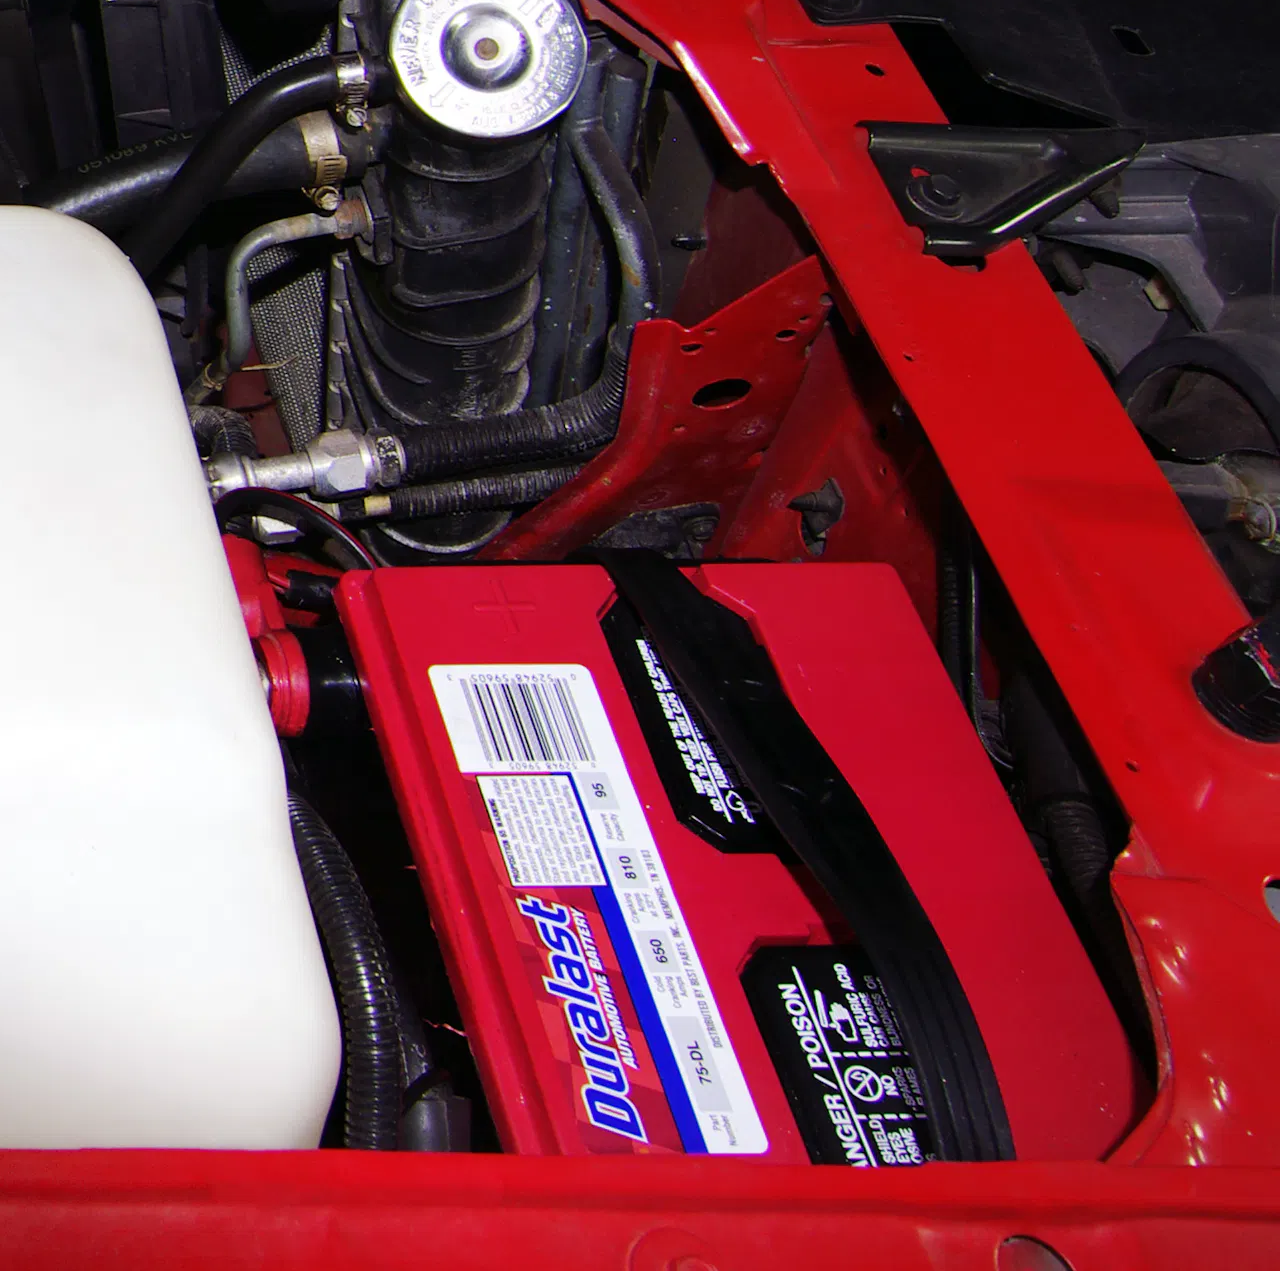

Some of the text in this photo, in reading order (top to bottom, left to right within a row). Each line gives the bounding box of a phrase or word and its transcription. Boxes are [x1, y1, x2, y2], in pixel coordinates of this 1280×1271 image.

[399, 19, 426, 85] NEVER
[635, 639, 658, 677] CHILDREN
[470, 673, 510, 683] 59605
[514, 672, 553, 682] 52948
[650, 679, 664, 690] OF
[656, 692, 674, 719] REACH
[666, 692, 683, 713] CAPS
[668, 721, 681, 737] THE
[675, 715, 692, 737] VENT
[674, 739, 688, 751] OF
[684, 738, 701, 759] KEEP
[508, 762, 541, 771] 59605
[544, 761, 578, 770] 52948
[681, 752, 696, 770] OUT
[689, 772, 704, 793] KEEP
[709, 762, 729, 787] FLUSH
[592, 782, 606, 797] 95
[701, 779, 716, 796] NOT
[709, 798, 722, 811] DO
[598, 813, 614, 839] Reserve
[609, 812, 626, 841] Capacity
[501, 839, 521, 882] PROPOSITION
[618, 855, 636, 879] 810
[649, 872, 660, 882] TN
[623, 892, 641, 923] Cranking
[633, 892, 646, 912] Amps
[649, 938, 667, 963] 650
[572, 907, 635, 1068] AUTOMOTIVE BATTERY
[653, 975, 665, 992] Cold
[674, 975, 688, 997] Amps
[686, 968, 698, 985] BEST
[863, 975, 877, 989] OR
[664, 975, 682, 1008] Cranking
[692, 988, 704, 998] BY
[831, 963, 878, 1047] SULFURIC ACID
[513, 894, 648, 1141] Duralast
[697, 1000, 722, 1047] DISTRIBUTED
[777, 983, 828, 1068] POISON
[858, 991, 889, 1046] CAN CAUSE
[872, 992, 900, 1046] BLINDNESS
[686, 1040, 710, 1083] 75-DL
[879, 1074, 899, 1095] NO
[891, 1066, 915, 1105] SPARKS
[708, 1114, 721, 1131] Part
[719, 1114, 737, 1145] Number
[868, 1119, 896, 1163] SHIELD
[886, 1131, 910, 1162] EYES
